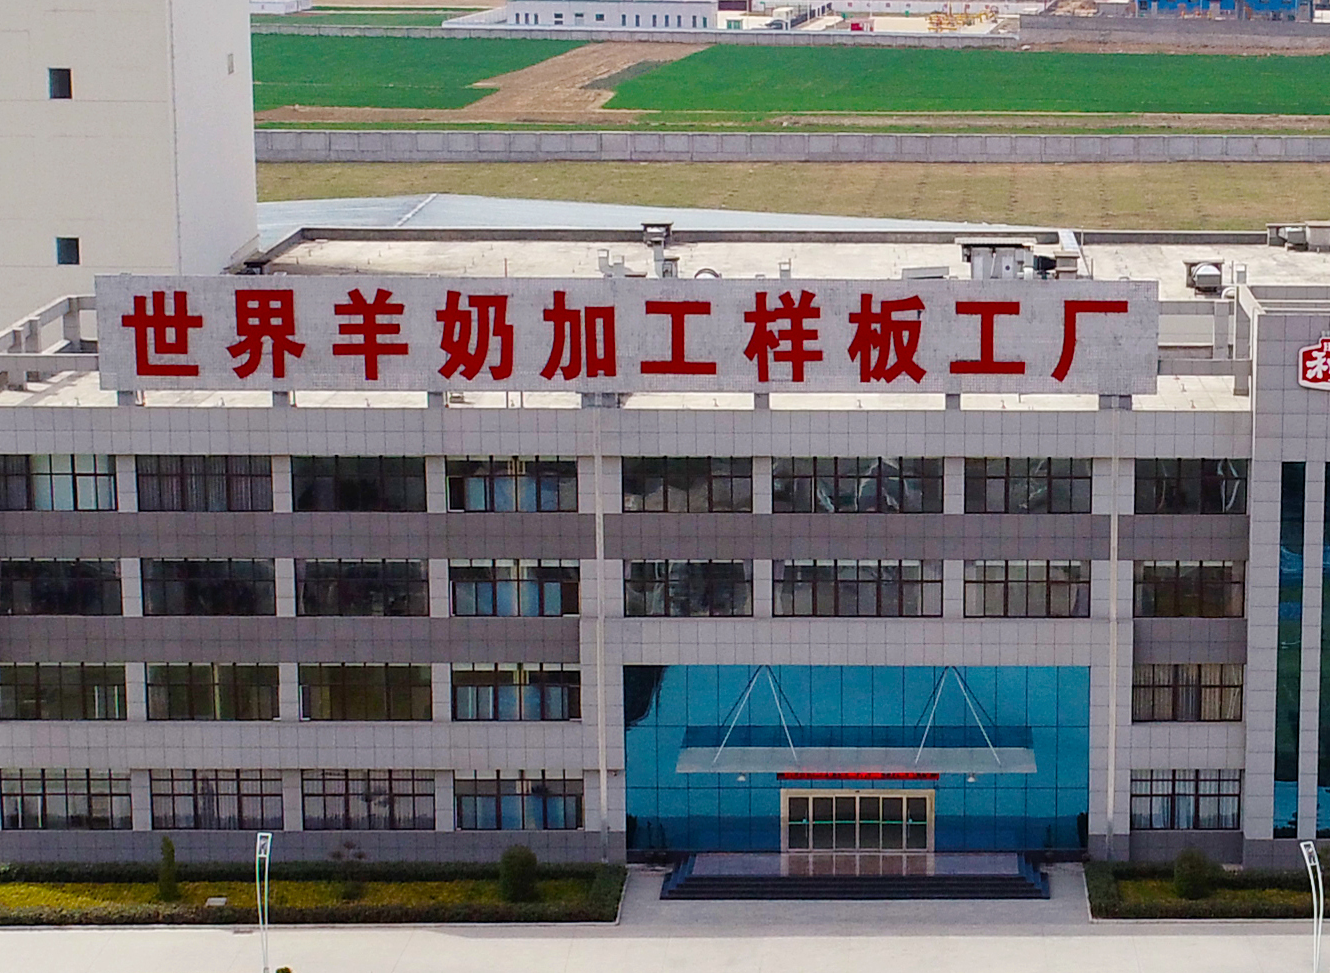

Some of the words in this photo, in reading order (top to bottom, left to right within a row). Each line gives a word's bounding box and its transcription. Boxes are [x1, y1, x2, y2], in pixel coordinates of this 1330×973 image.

[122, 289, 1129, 384] 世界羊奶加工样板工厂
